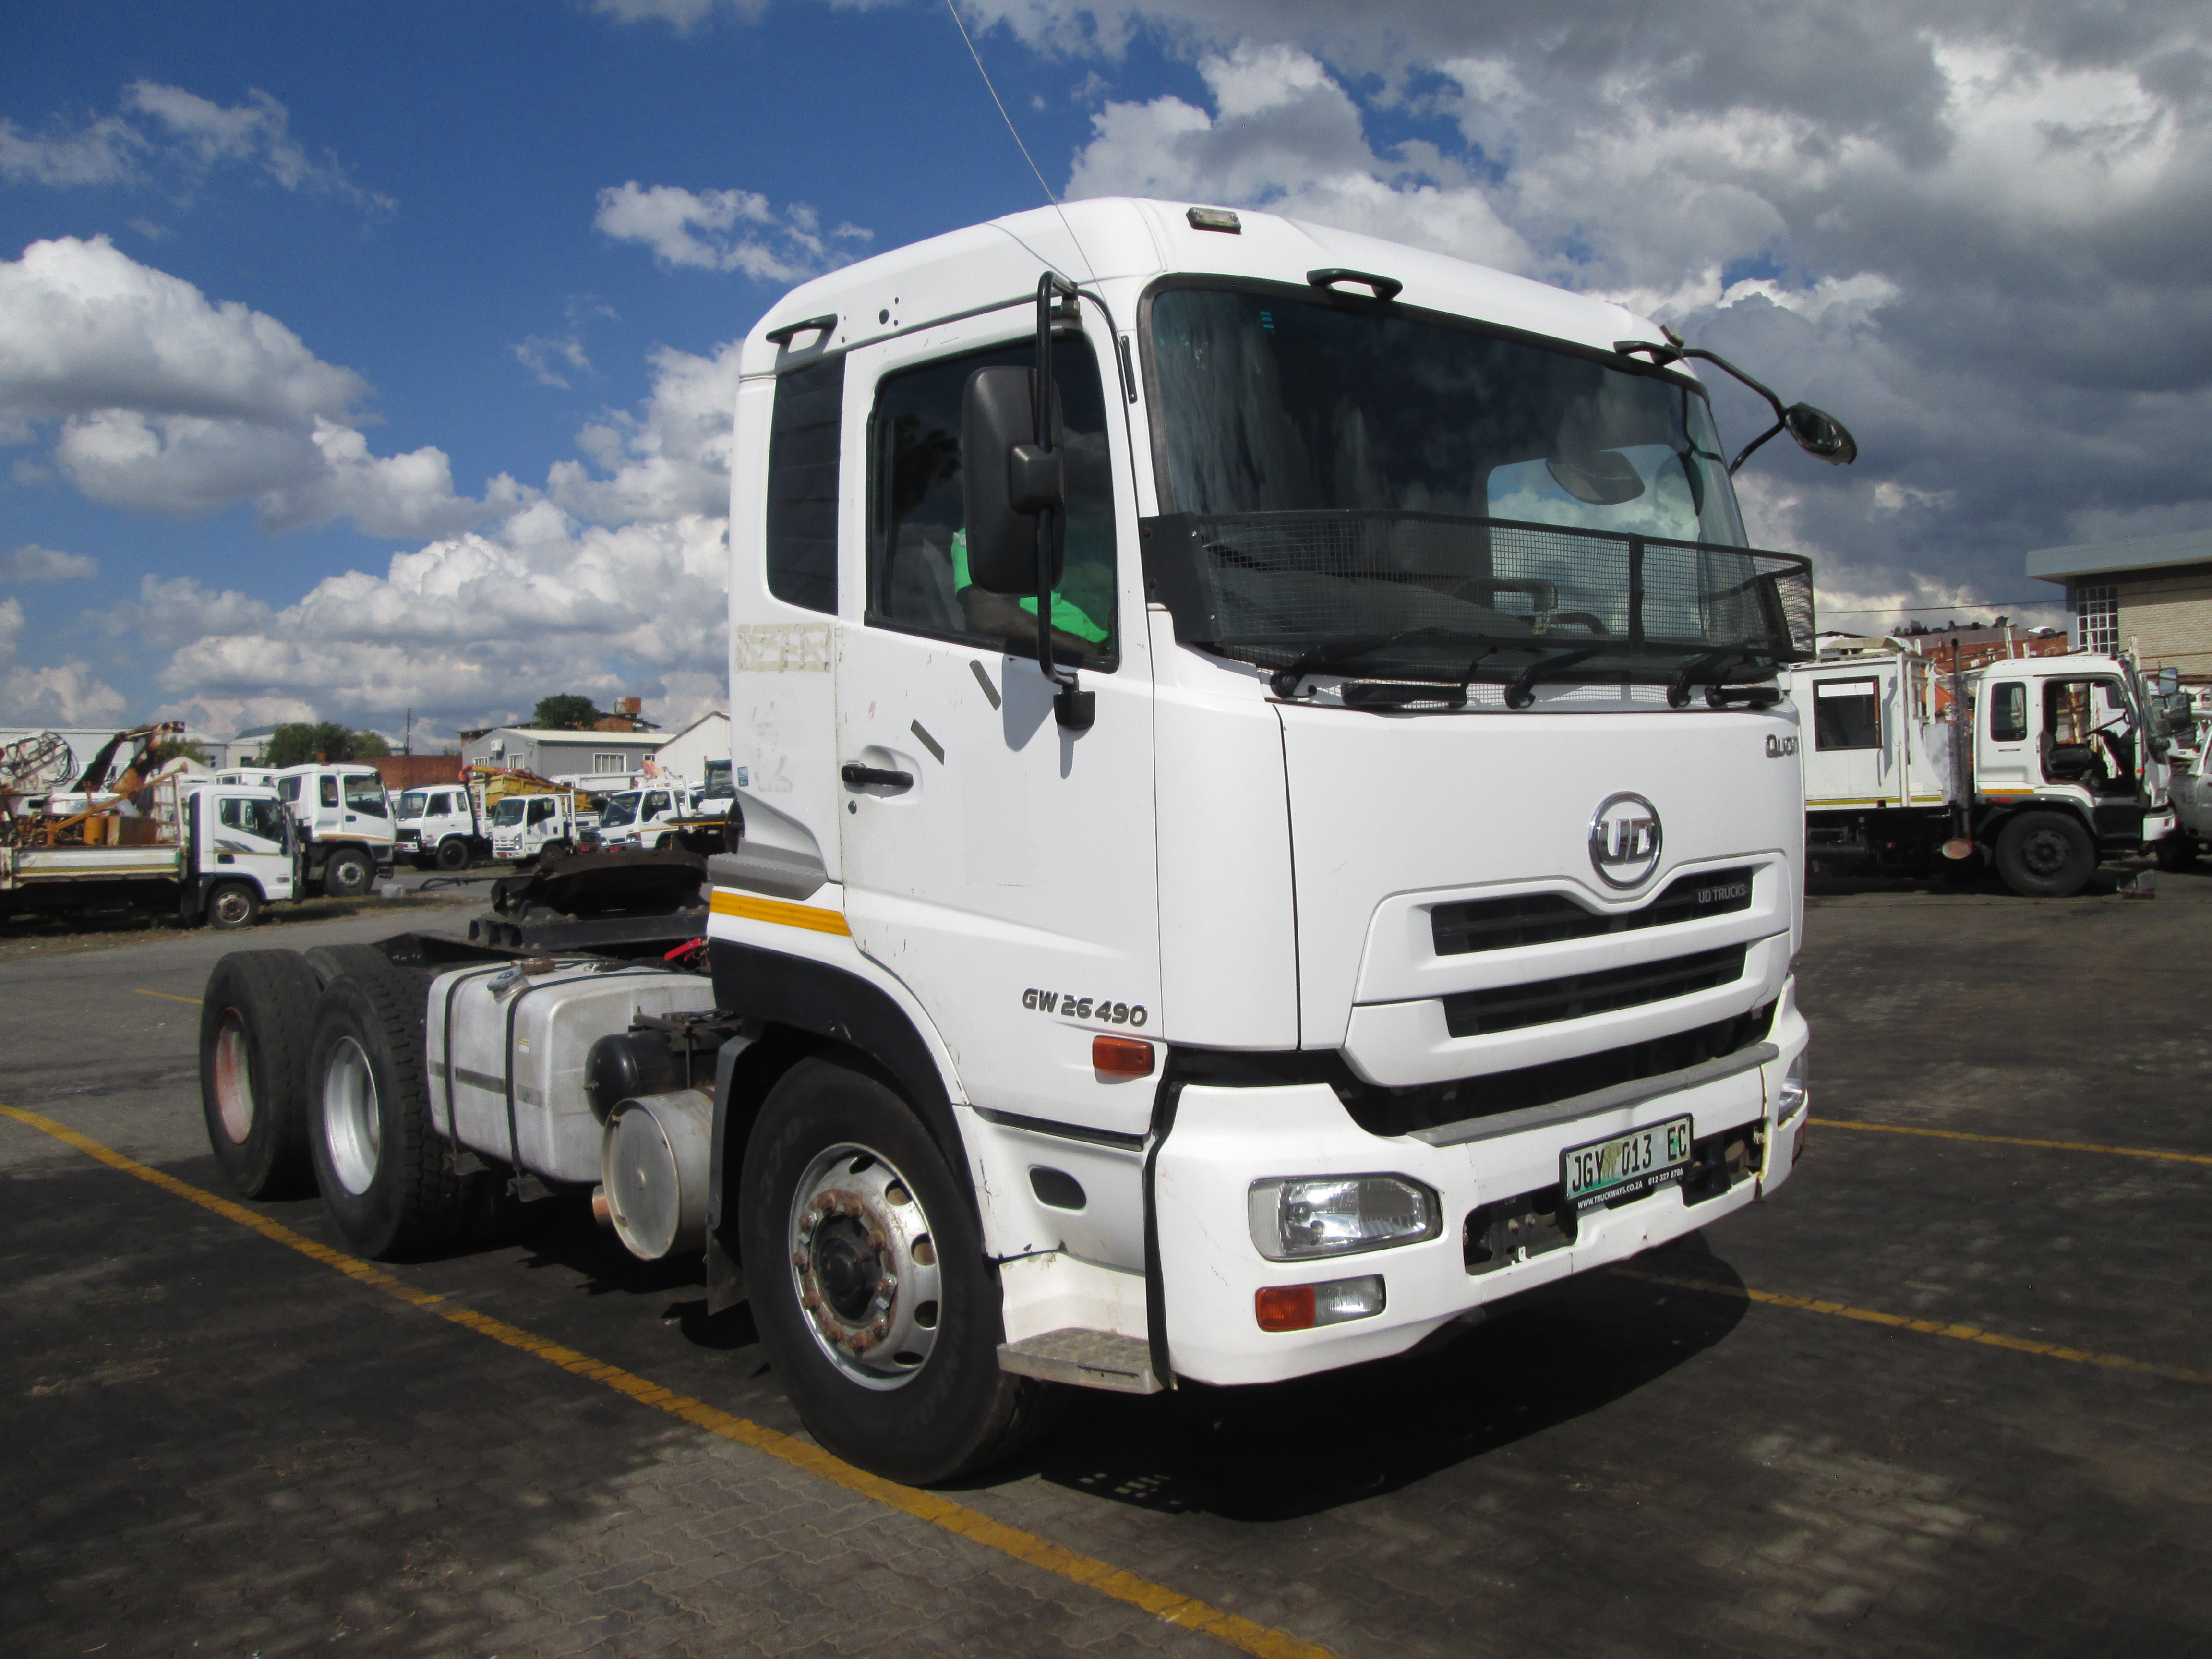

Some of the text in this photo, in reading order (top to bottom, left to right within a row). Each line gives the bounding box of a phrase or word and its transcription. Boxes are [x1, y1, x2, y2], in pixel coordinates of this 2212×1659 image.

[1596, 817, 1659, 865] UD
[1698, 884, 1746, 903] UD TRUCKS
[1022, 988, 1148, 1027] GW 26 490
[1572, 1124, 1686, 1192] JGY 013 EC
[1577, 1180, 1643, 1209] WWW.TRUCKWAYS.CO.ZA
[1648, 1175, 1659, 1185] 012
[1659, 1172, 1670, 1181] 327
